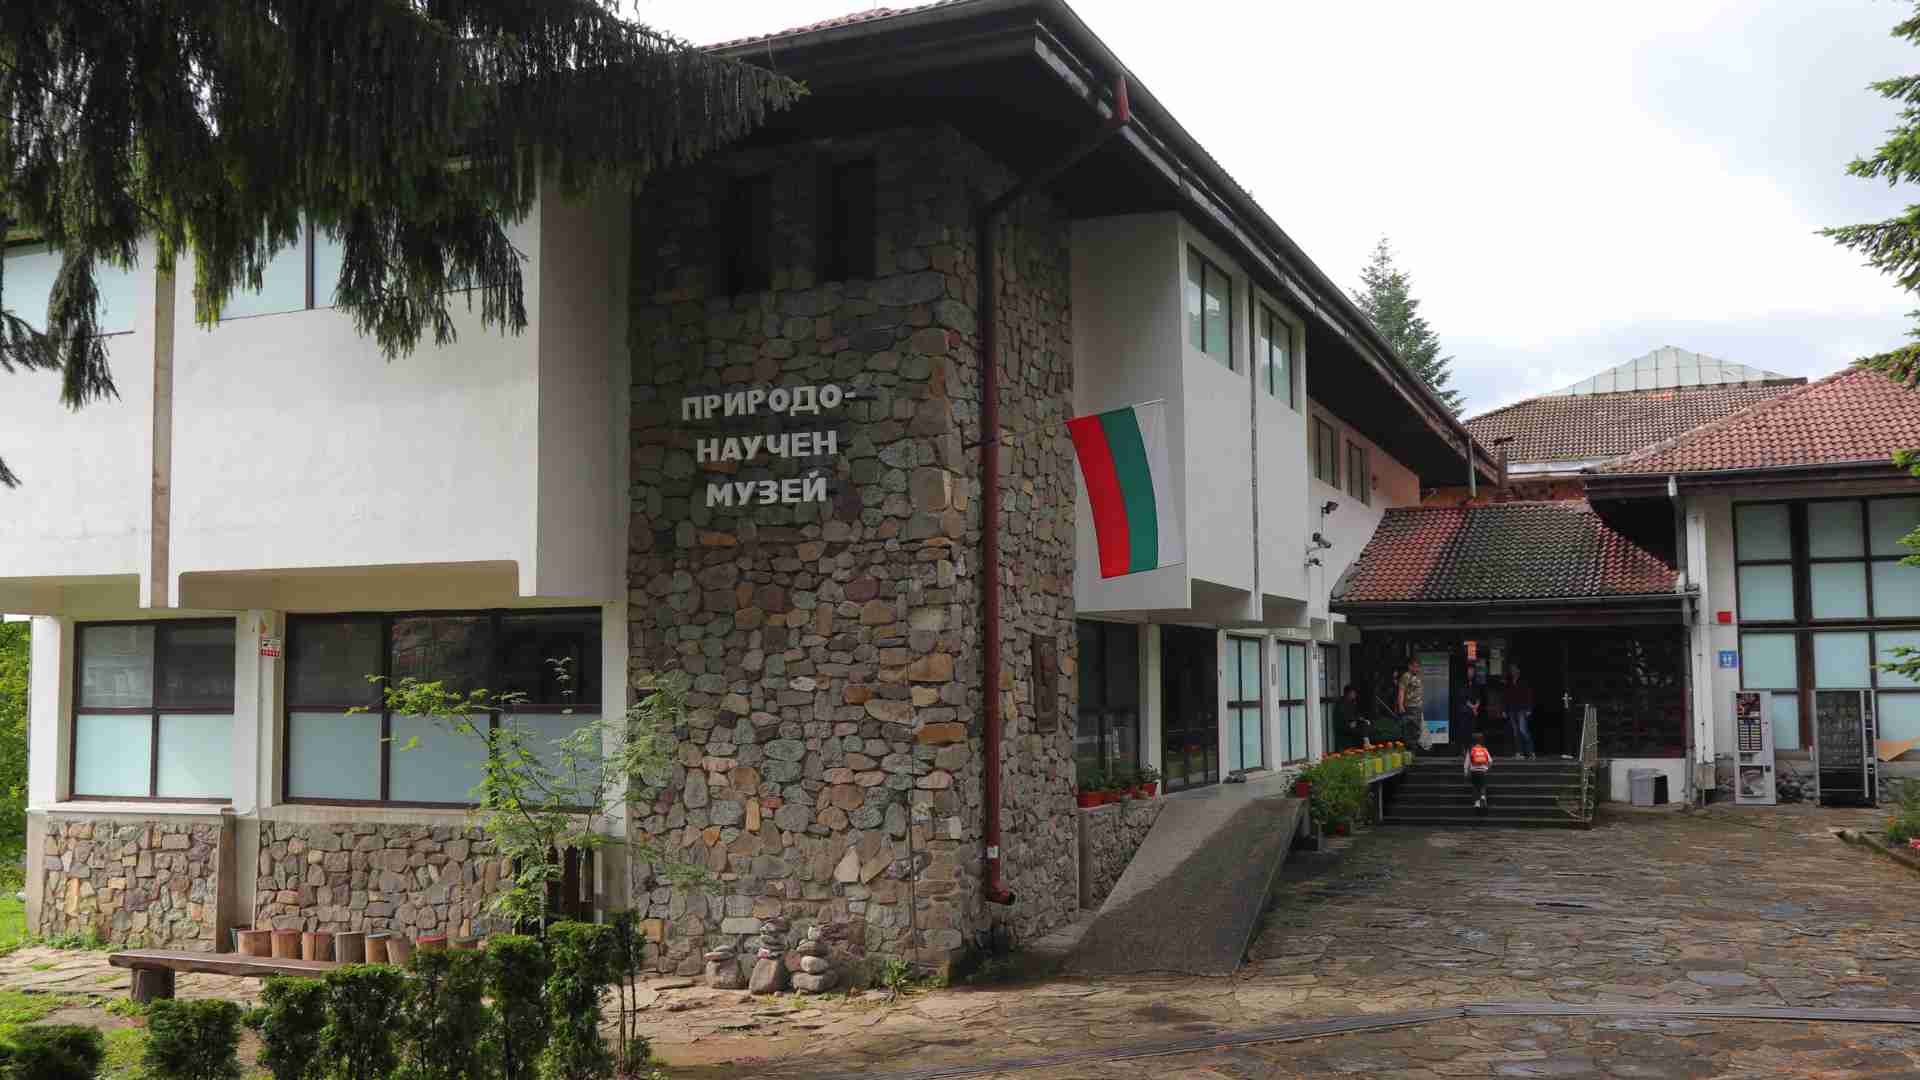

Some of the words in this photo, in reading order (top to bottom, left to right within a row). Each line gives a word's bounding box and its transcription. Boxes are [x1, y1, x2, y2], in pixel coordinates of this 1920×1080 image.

[681, 384, 857, 421] ПРИРОДО-
[697, 430, 838, 463] НАУЧЕН
[705, 470, 827, 508] МУЗЕЙ
